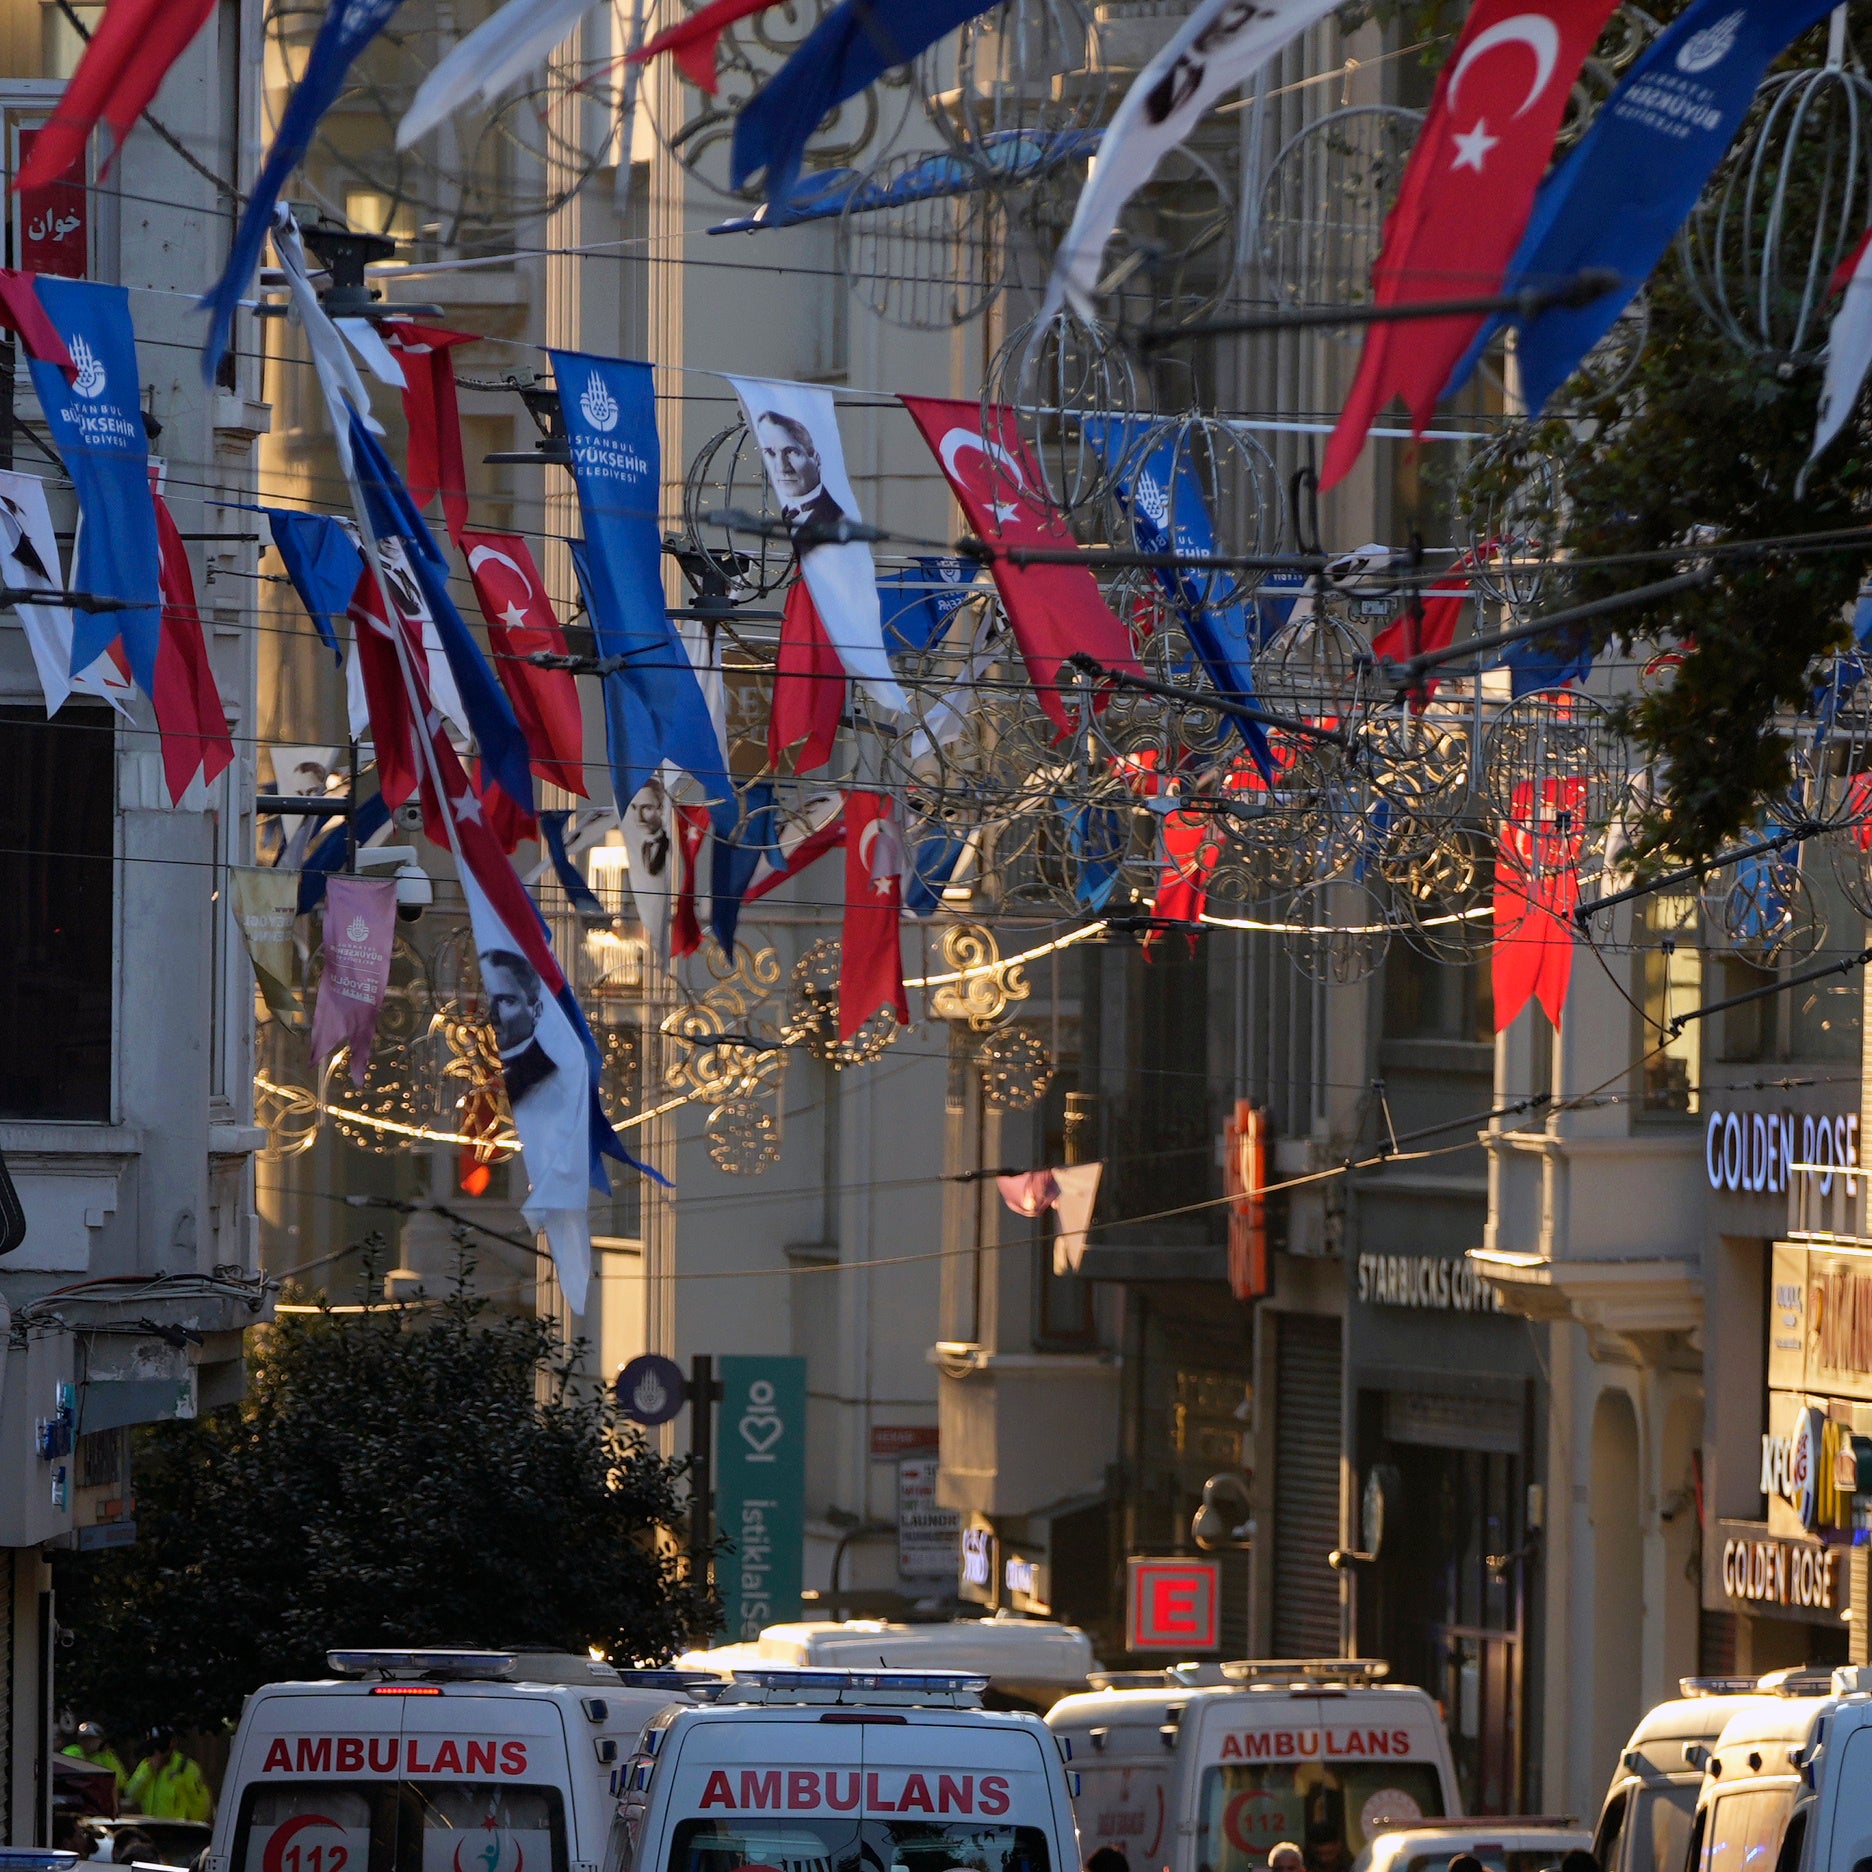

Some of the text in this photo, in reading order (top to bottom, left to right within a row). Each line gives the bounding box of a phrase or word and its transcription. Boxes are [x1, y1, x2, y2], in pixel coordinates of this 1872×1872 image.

[1707, 1110, 1860, 1199] GOLDEN ROSE
[1358, 1252, 1449, 1310] STARBUCKS
[1722, 1537, 1836, 1609] GOLDEN ROSE
[1154, 1580, 1198, 1632] E
[262, 1737, 528, 1777] AMBULANS
[1221, 1727, 1409, 1761] AMBULANS
[698, 1768, 1011, 1817] AMBULANS
[1244, 1811, 1285, 1833] 112
